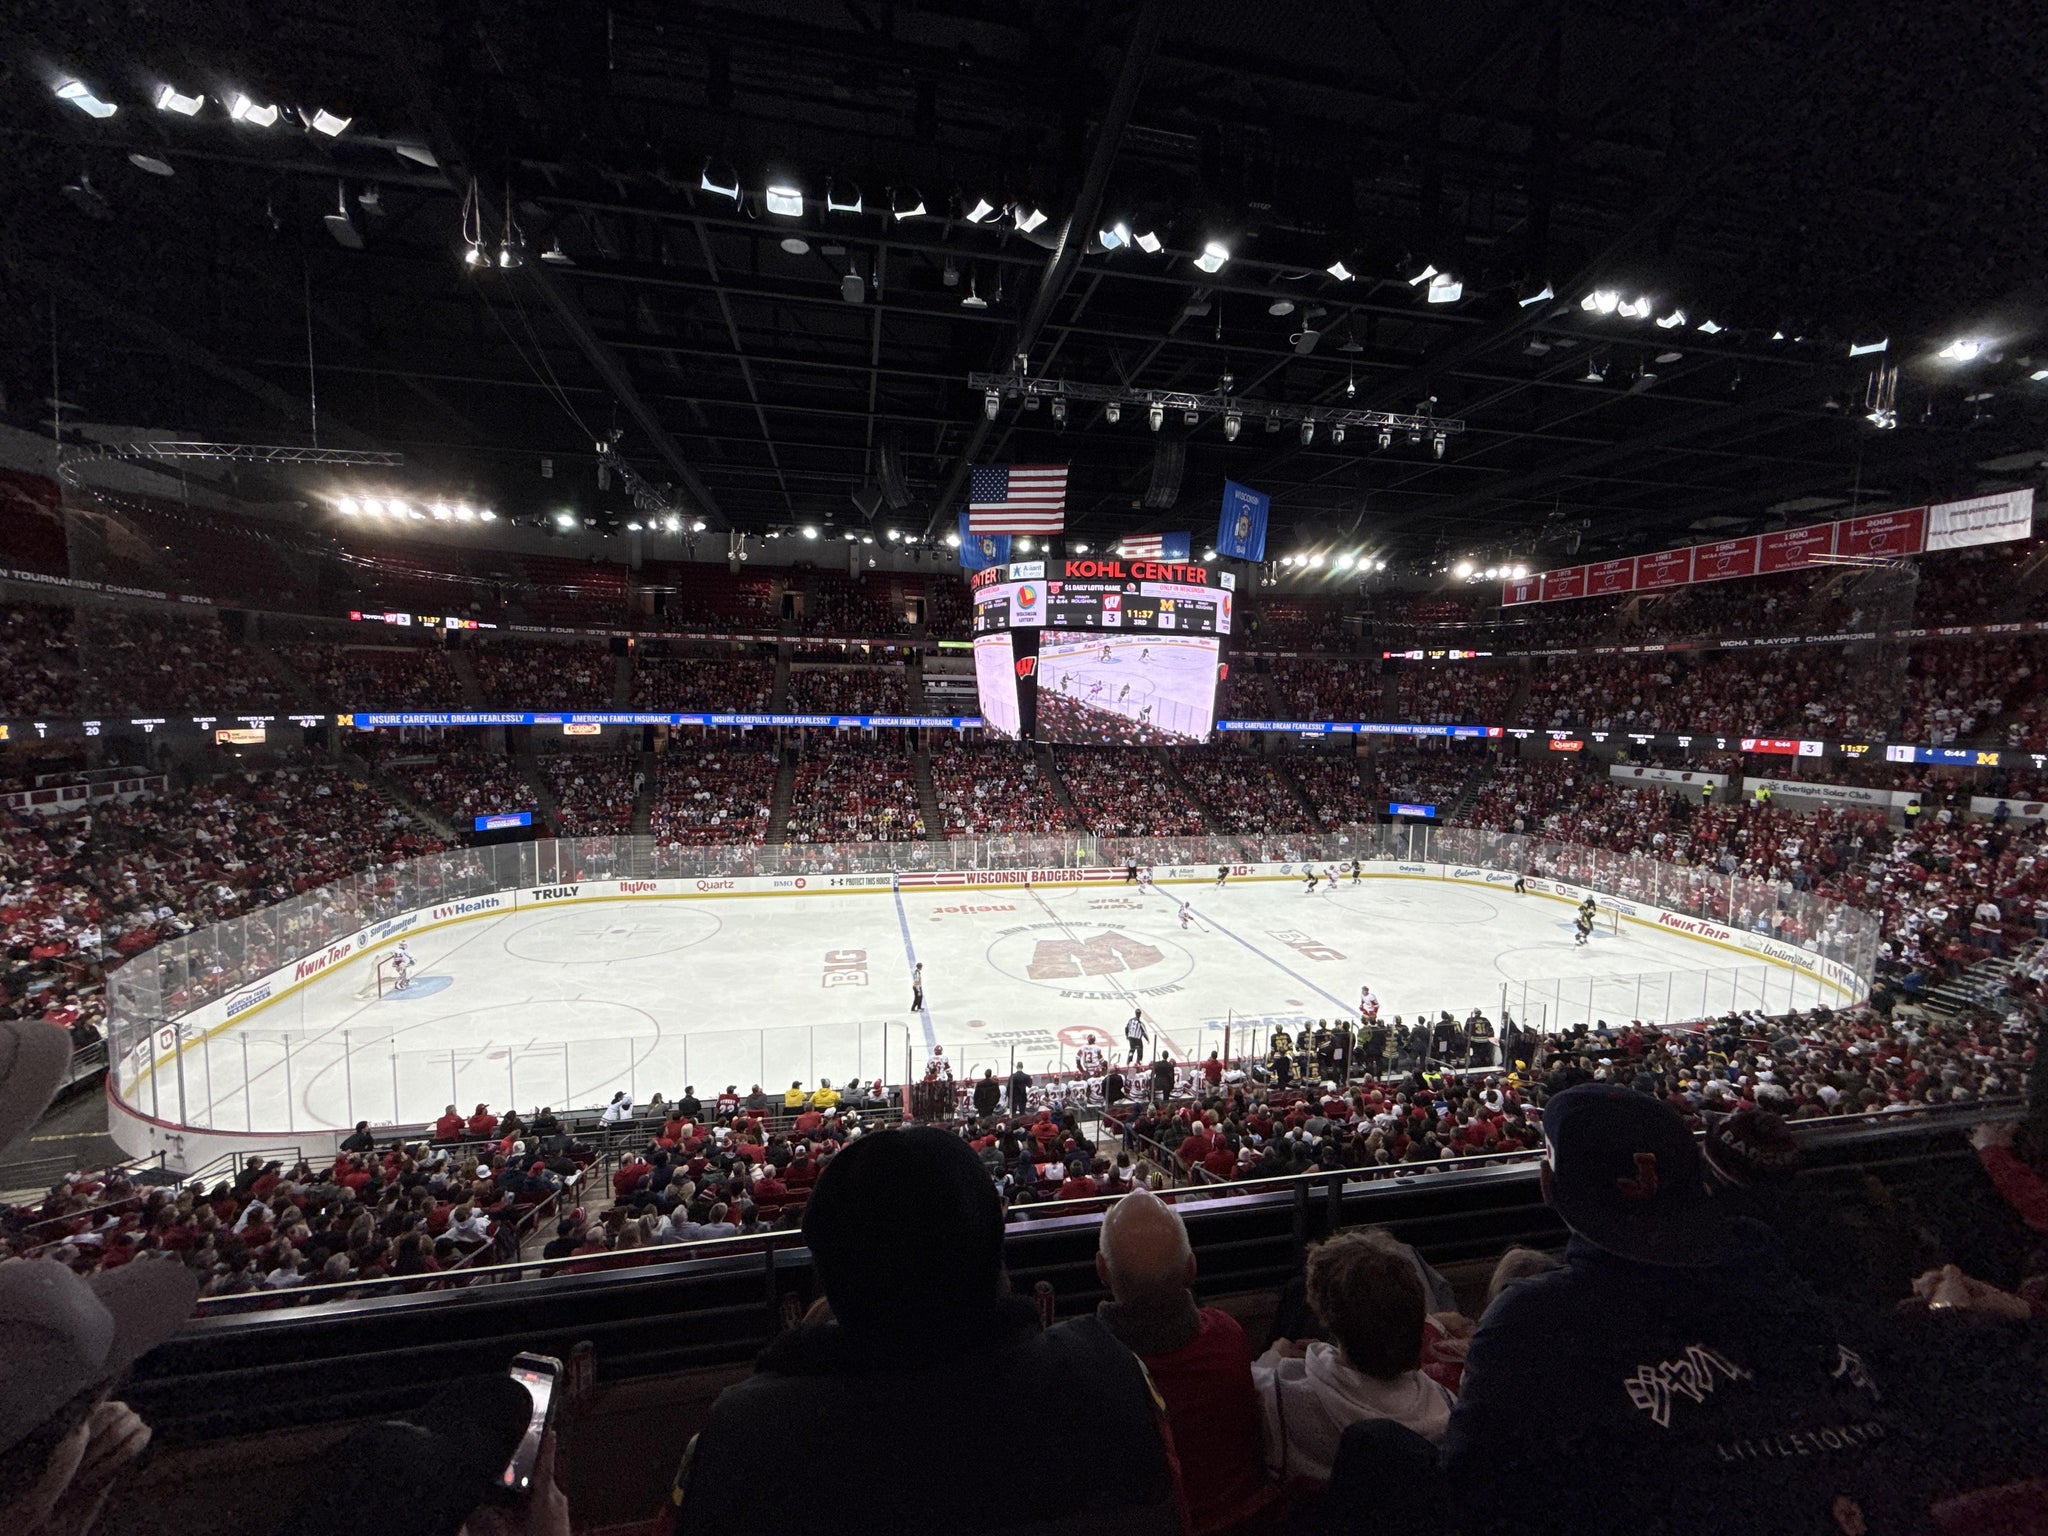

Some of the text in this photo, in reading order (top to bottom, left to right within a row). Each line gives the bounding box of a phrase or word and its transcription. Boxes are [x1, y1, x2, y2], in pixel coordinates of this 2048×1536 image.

[1065, 560, 1207, 584] KOHL CENTER
[12, 570, 102, 590] TOURNAMENT
[106, 584, 166, 600] CHAMPIONS
[181, 595, 212, 604] 2014
[1516, 586, 1528, 601] 10
[1108, 614, 1116, 622] 3
[1127, 610, 1154, 618] 11:37
[418, 616, 440, 624] 11:37
[1164, 616, 1170, 624] 1
[1720, 639, 1748, 648] WCHA
[1754, 636, 1800, 646] PLAYOFF
[1805, 632, 1876, 643] CHAMPIONS
[1984, 624, 2021, 632] 1973
[337, 714, 354, 726] M
[369, 714, 401, 724] INSURE
[451, 714, 478, 724] DREAM
[479, 714, 524, 723] FEARLESSLY
[572, 714, 608, 724] AMERICAN
[609, 714, 634, 724] FAMILY
[634, 715, 672, 724] INSURANCE
[712, 716, 734, 724] INSURE
[772, 716, 794, 724] DREAM
[794, 716, 830, 725] FEARLESSLY
[868, 718, 899, 726] AMERICAN
[900, 718, 920, 726] FAMILY
[920, 718, 952, 726] INSURANCE
[144, 724, 154, 732] 17
[250, 721, 265, 729] 1/2
[1412, 726, 1447, 734] INSURANCE
[38, 729, 44, 738] 1
[86, 727, 100, 736] 20
[1554, 740, 1578, 750] Quartz
[1806, 744, 1814, 753] 3
[1840, 744, 1869, 754] 11:37
[1898, 750, 1904, 759] 1
[1976, 752, 1999, 766] M
[2036, 760, 2042, 768] 1
[1782, 784, 1872, 800] Everlight Solar Club
[966, 870, 1083, 884] WISCONSIN BADGERS
[1454, 868, 1481, 879] Culver's
[1486, 873, 1512, 882] Culver's
[696, 880, 734, 892] Quartz
[532, 886, 578, 900] TRULY
[933, 904, 1016, 914] meijer
[370, 920, 392, 938] Siding
[382, 914, 418, 939] Unlimited
[1658, 912, 1730, 942] KWIK TRIP
[1762, 943, 1815, 971] Unlimited
[294, 944, 351, 982] KWIK TRIP
[1060, 984, 1184, 1000] KOHL CENTER
[226, 994, 253, 1012] AMERICAN
[1084, 1052, 1092, 1063] 13
